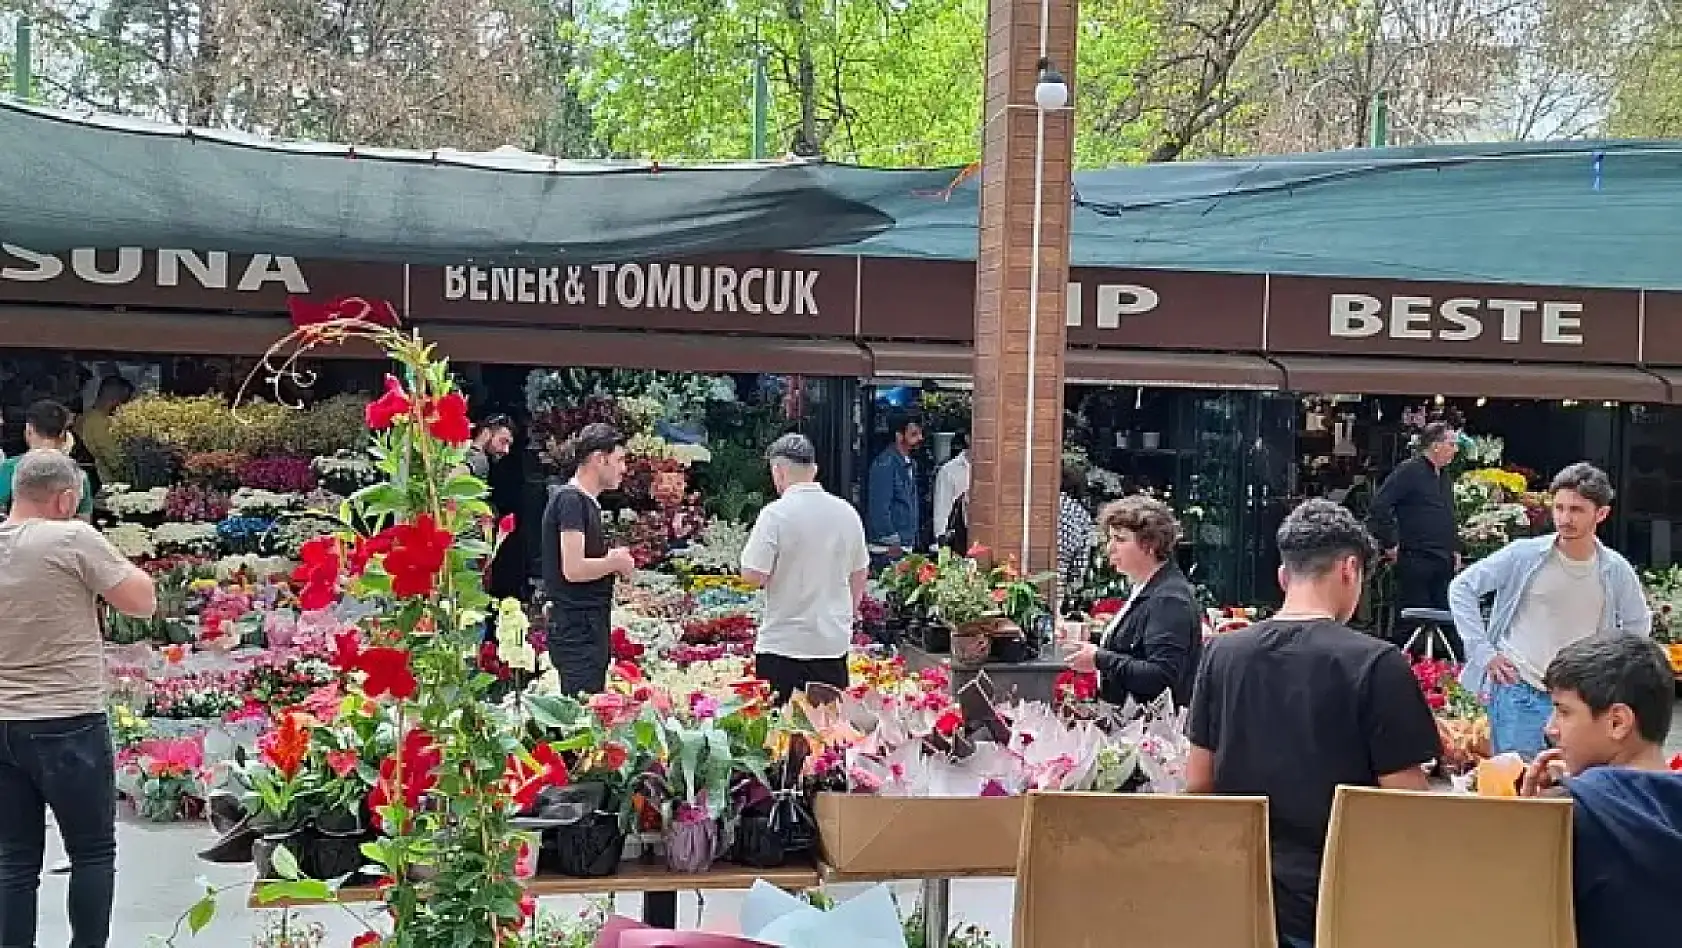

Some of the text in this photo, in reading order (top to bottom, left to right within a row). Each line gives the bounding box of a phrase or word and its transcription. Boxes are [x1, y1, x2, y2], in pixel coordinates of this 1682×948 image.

[2, 242, 310, 294] SUNA
[564, 265, 586, 304] &
[592, 264, 819, 315] TOMURCUK
[1330, 293, 1584, 345] BESTE
